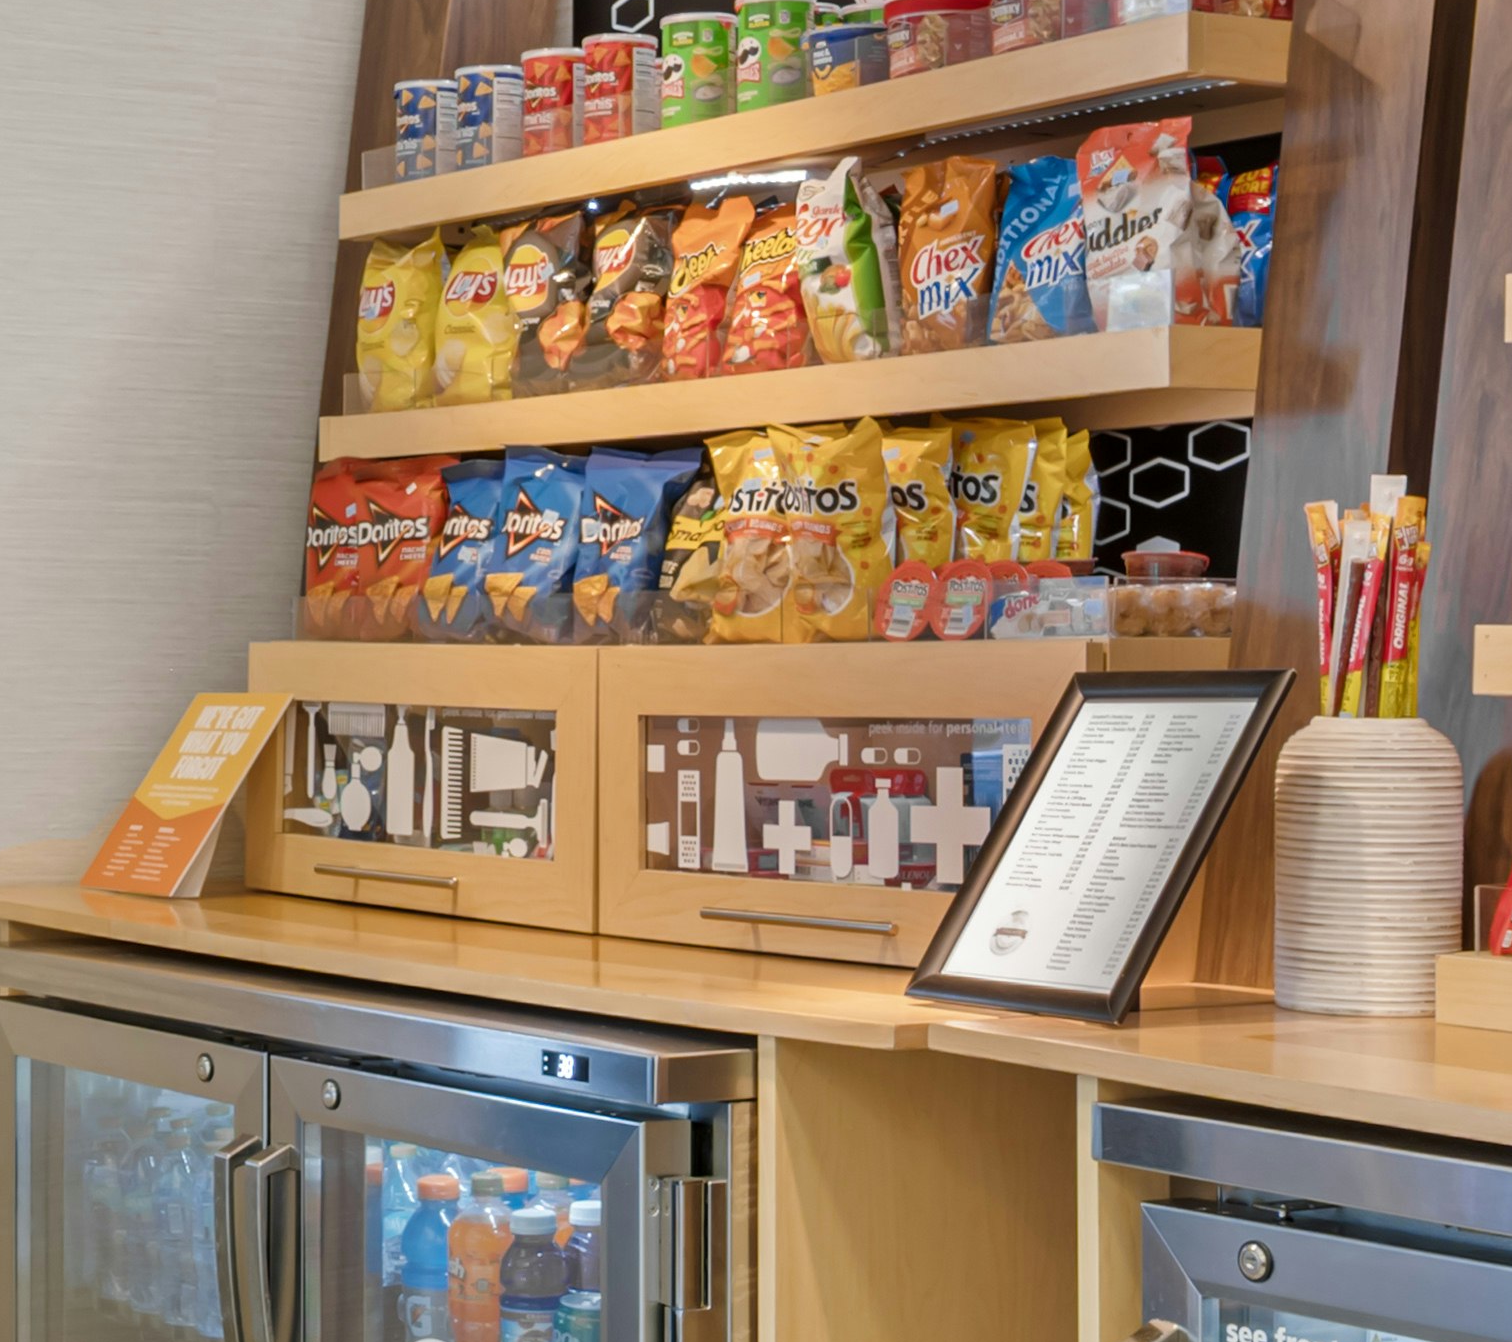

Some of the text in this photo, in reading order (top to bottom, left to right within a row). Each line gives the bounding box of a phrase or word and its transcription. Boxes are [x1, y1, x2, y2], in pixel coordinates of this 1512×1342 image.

[912, 236, 985, 286] Chex
[446, 269, 498, 302] Lay's
[358, 517, 429, 545] Doritos
[1394, 582, 1409, 650] ORIGINAL
[557, 1054, 574, 1079] 38
